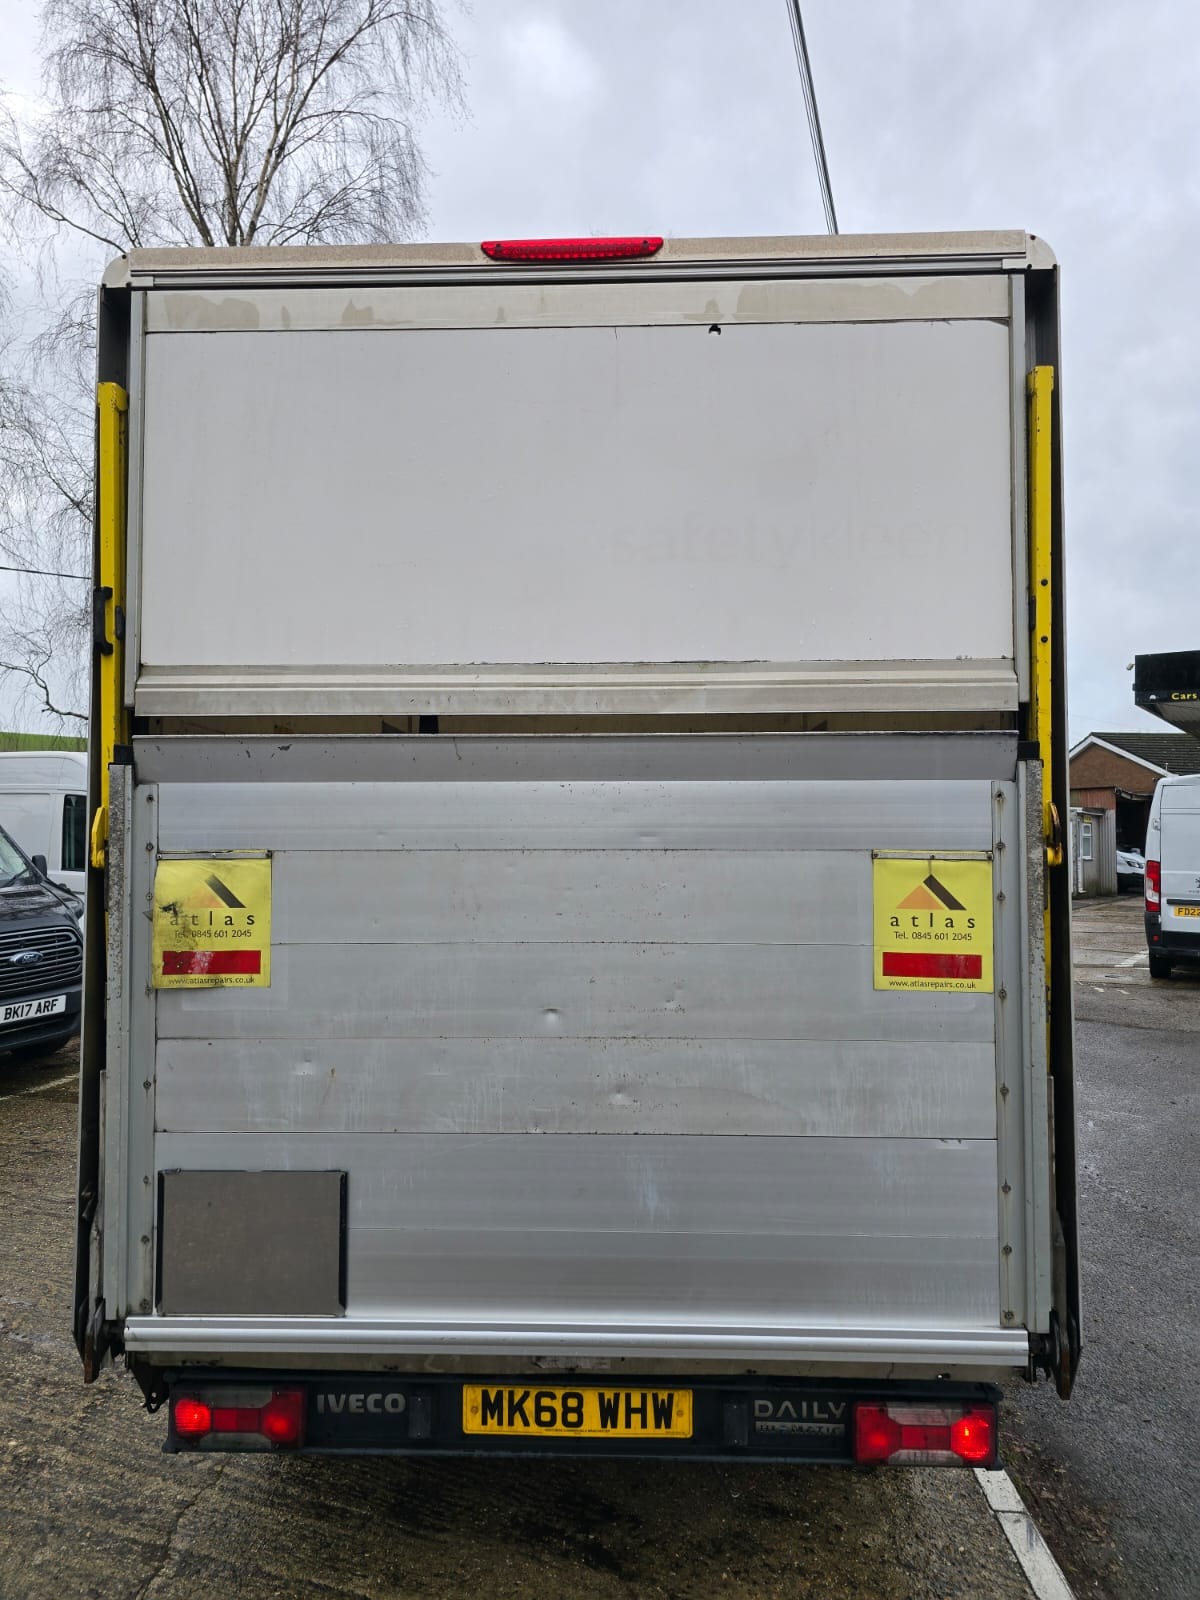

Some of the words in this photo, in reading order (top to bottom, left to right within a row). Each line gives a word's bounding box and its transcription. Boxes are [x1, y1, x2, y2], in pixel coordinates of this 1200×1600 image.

[1171, 692, 1198, 700] Cars
[170, 911, 255, 926] atlas
[890, 912, 976, 928] atlas
[191, 930, 212, 938] 0845
[214, 930, 228, 938] 601
[231, 929, 252, 938] 2045
[894, 931, 908, 940] Tel.
[911, 931, 932, 940] 0845
[934, 932, 949, 940] 601
[952, 932, 972, 941] 2045
[168, 976, 255, 985] www.atlasrepairs.co.uk
[888, 980, 976, 989] www.atlasrepairs.co.uk
[4, 1003, 33, 1021] BK17
[35, 998, 59, 1015] ARF
[316, 1393, 406, 1414] IVECO
[481, 1389, 584, 1428] MK68
[598, 1391, 675, 1430] WHW
[753, 1400, 847, 1419] DAILY
